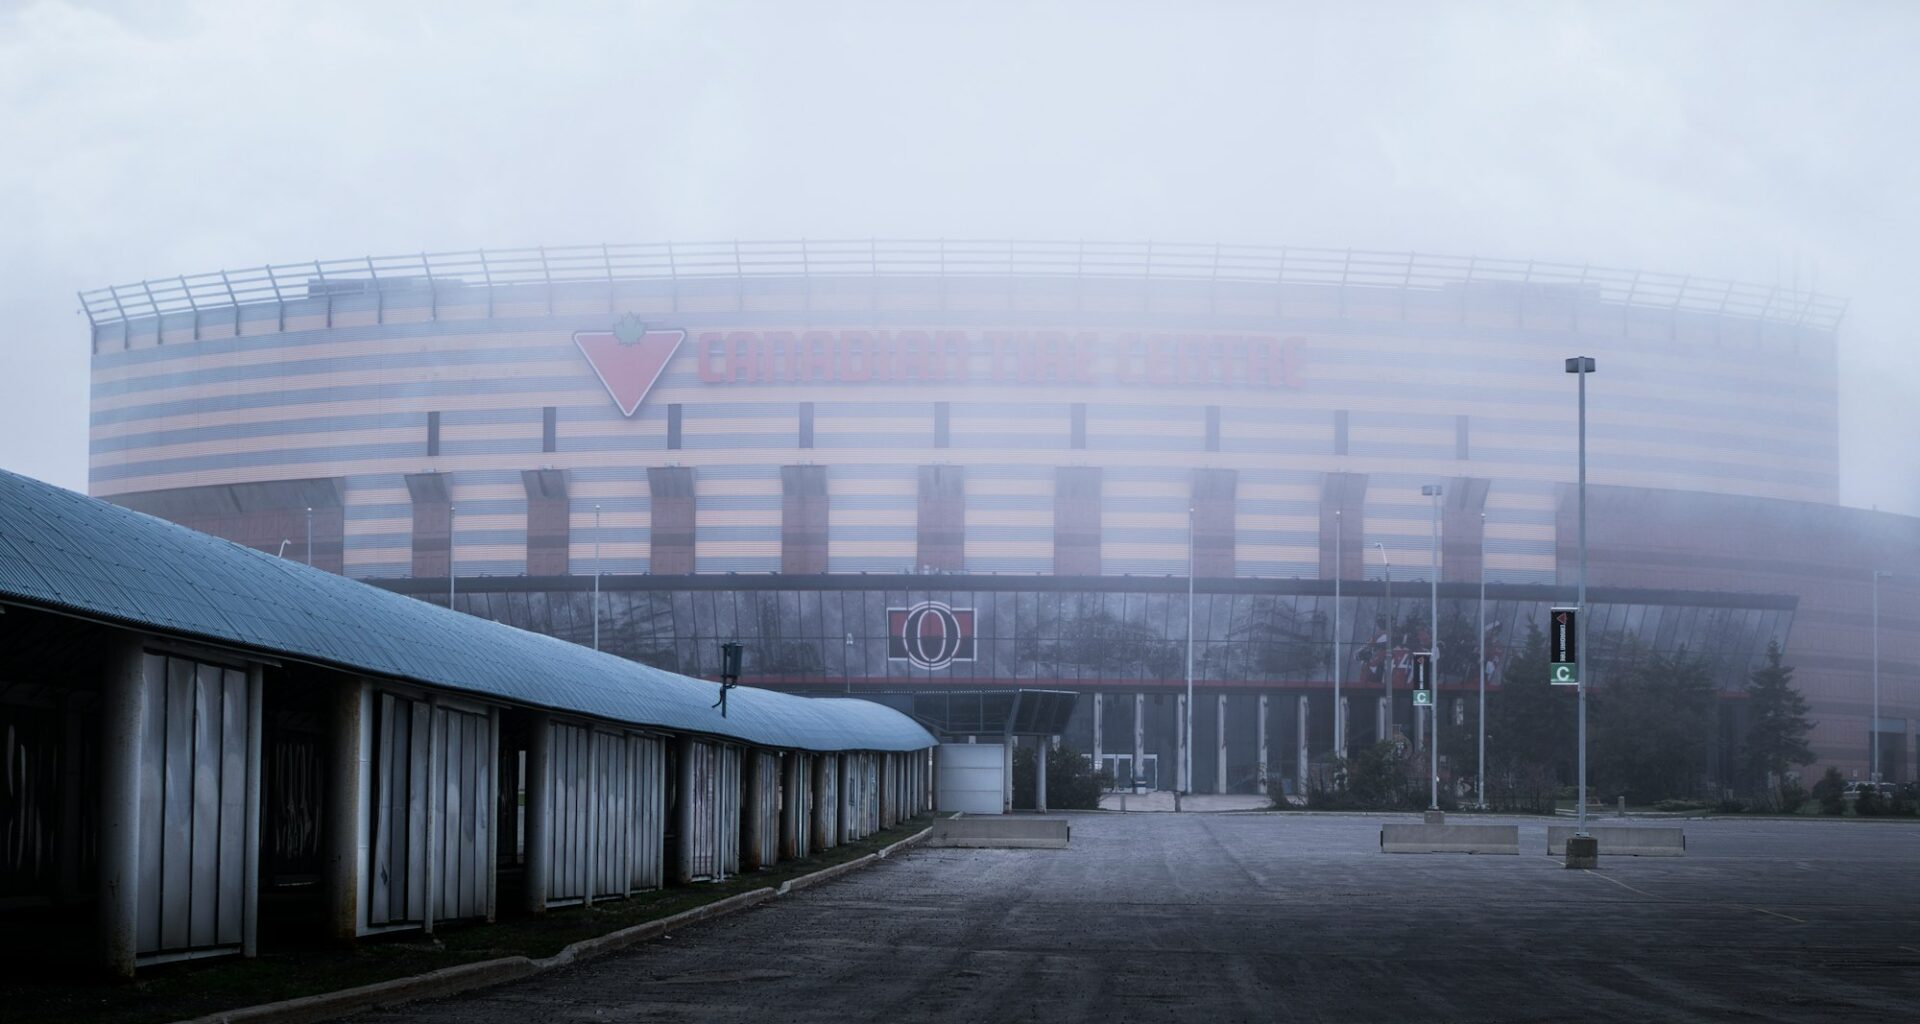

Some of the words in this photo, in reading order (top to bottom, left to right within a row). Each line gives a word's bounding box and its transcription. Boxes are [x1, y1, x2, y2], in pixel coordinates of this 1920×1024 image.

[697, 330, 970, 384] CANADIAN
[983, 330, 1099, 385] TIRE
[1119, 332, 1308, 388] CENTRE
[903, 601, 960, 670] O
[1556, 666, 1570, 681] C
[1417, 692, 1427, 703] C
